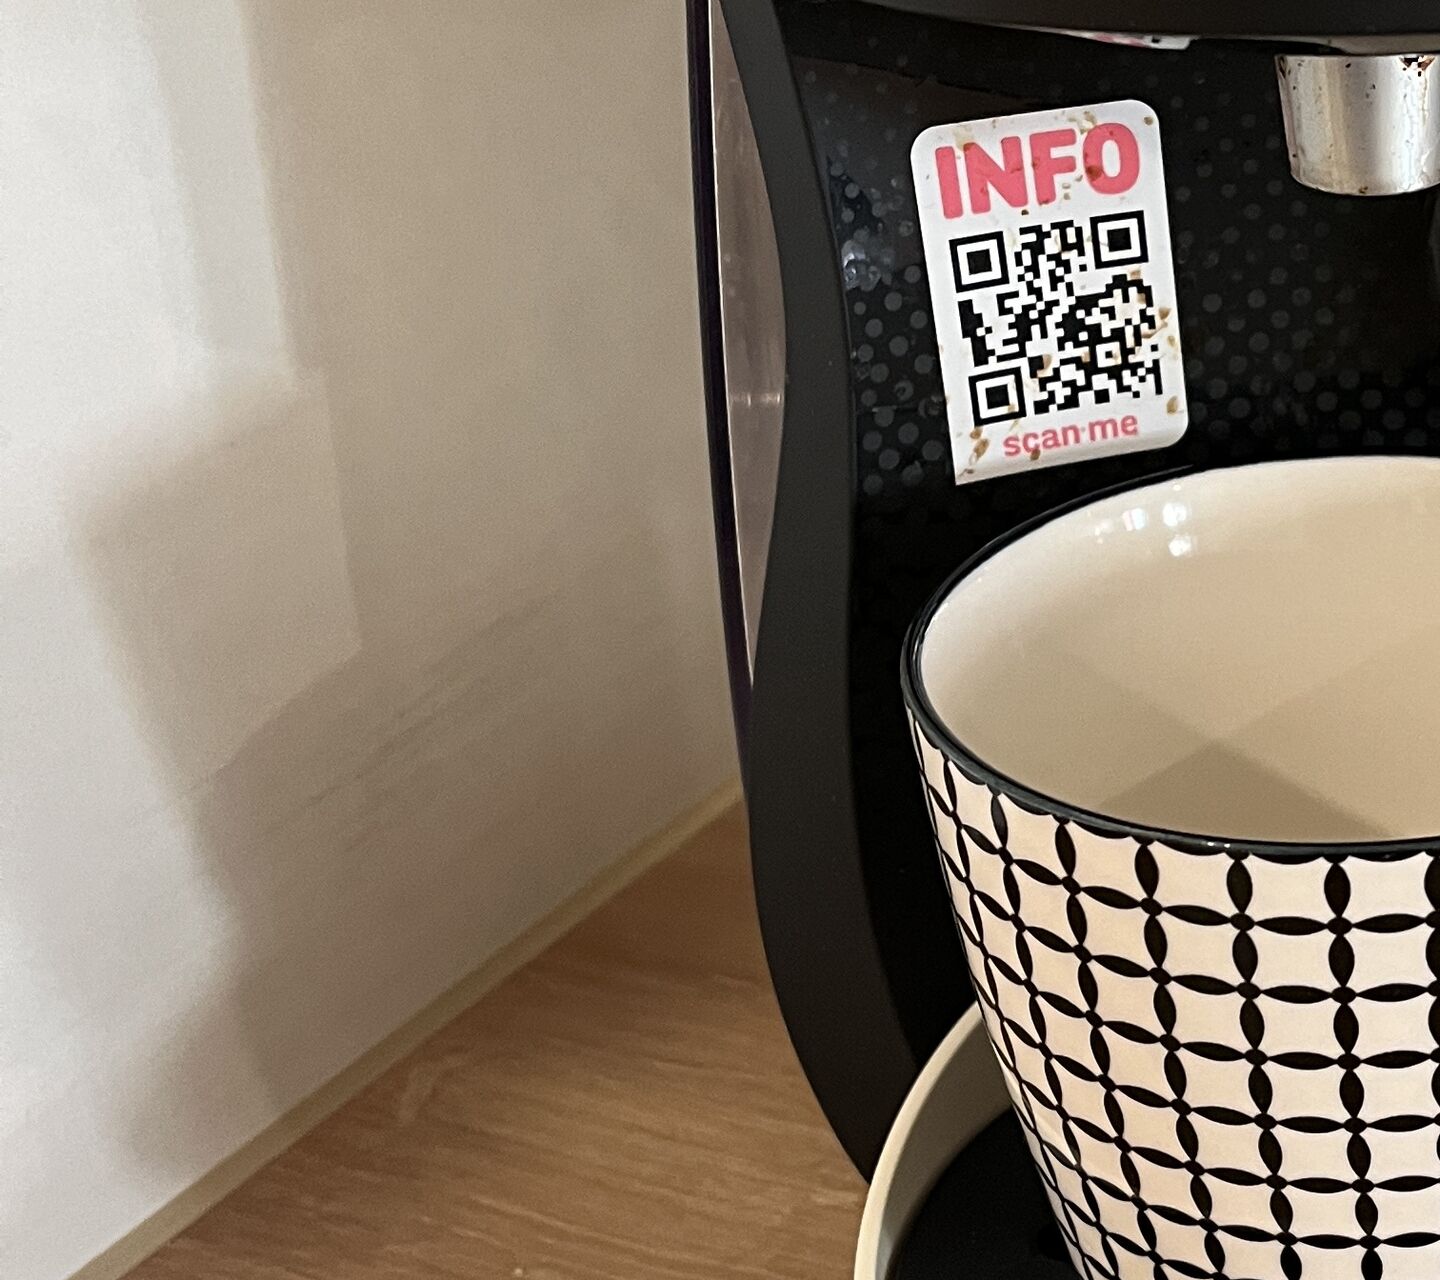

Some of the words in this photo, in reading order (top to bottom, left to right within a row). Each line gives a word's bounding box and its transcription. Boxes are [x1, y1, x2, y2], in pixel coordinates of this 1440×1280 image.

[934, 122, 1140, 220] INFO
[1002, 421, 1083, 458] scan
[1087, 413, 1139, 444] me
